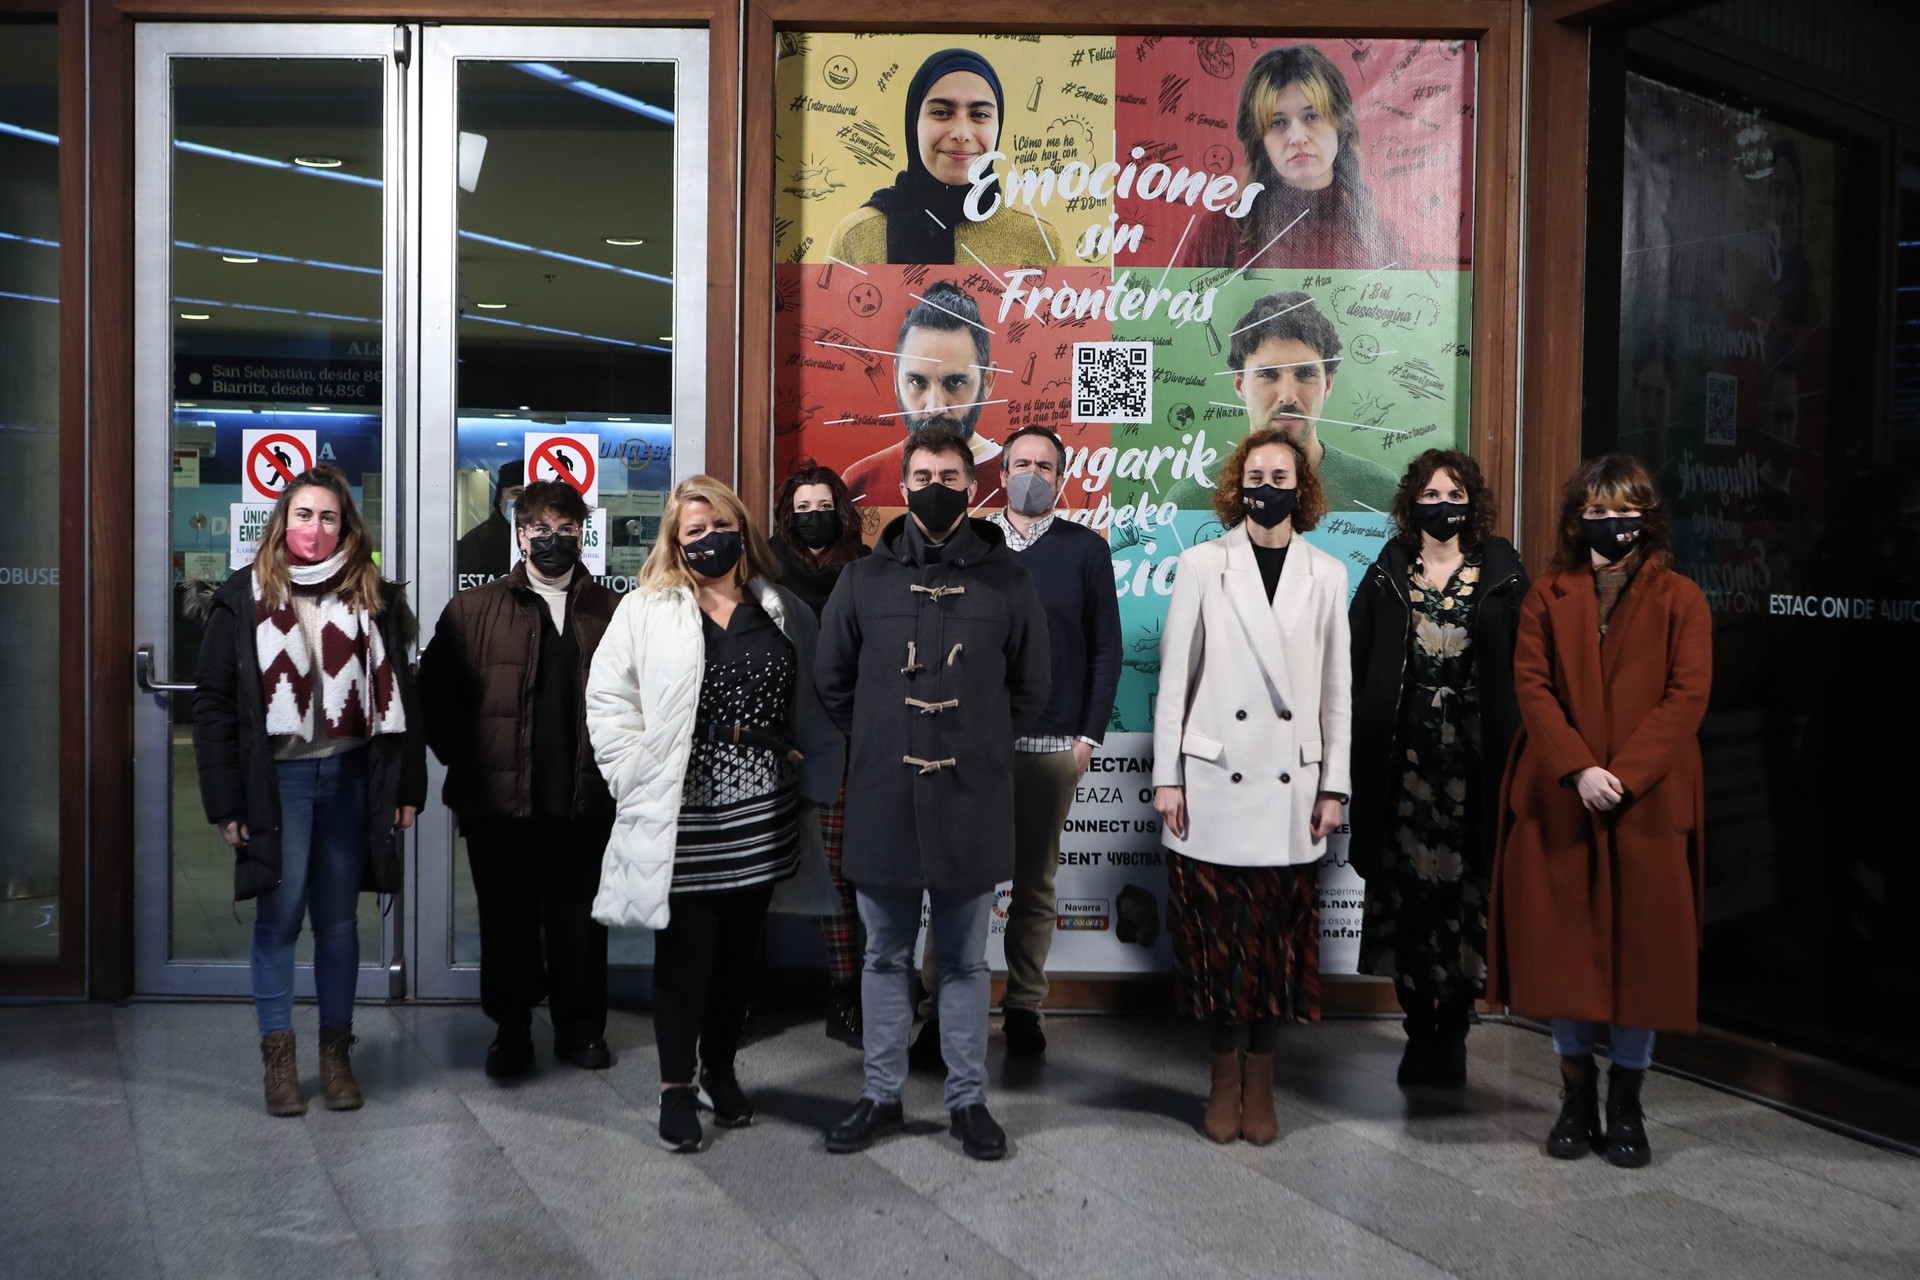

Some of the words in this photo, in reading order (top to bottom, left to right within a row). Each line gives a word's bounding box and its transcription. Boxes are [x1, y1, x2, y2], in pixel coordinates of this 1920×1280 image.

[1046, 137, 1061, 148] me
[1063, 134, 1075, 147] he
[1041, 149, 1061, 166] hoy
[1062, 147, 1078, 158] con
[962, 147, 1266, 222] Emociones
[1075, 212, 1145, 258] sin
[997, 269, 1220, 324] Fronteras
[212, 365, 241, 378] San
[319, 368, 360, 382] desde
[1153, 368, 1207, 387] #Diversidad
[212, 380, 269, 396] Biarritz,
[271, 383, 314, 395] desde
[317, 384, 366, 398] 14,85€
[1010, 416, 1021, 425] en
[1023, 412, 1032, 424] el
[1052, 410, 1070, 421] todo
[1203, 407, 1245, 421] #Nazka
[1062, 429, 1219, 493] ugarik
[1327, 518, 1387, 538] #Diversidad
[1111, 542, 1180, 598] zio
[1852, 598, 1874, 620] DE
[1086, 757, 1154, 773] ECTAN
[1134, 819, 1157, 833] US
[1064, 903, 1101, 911] Navarra
